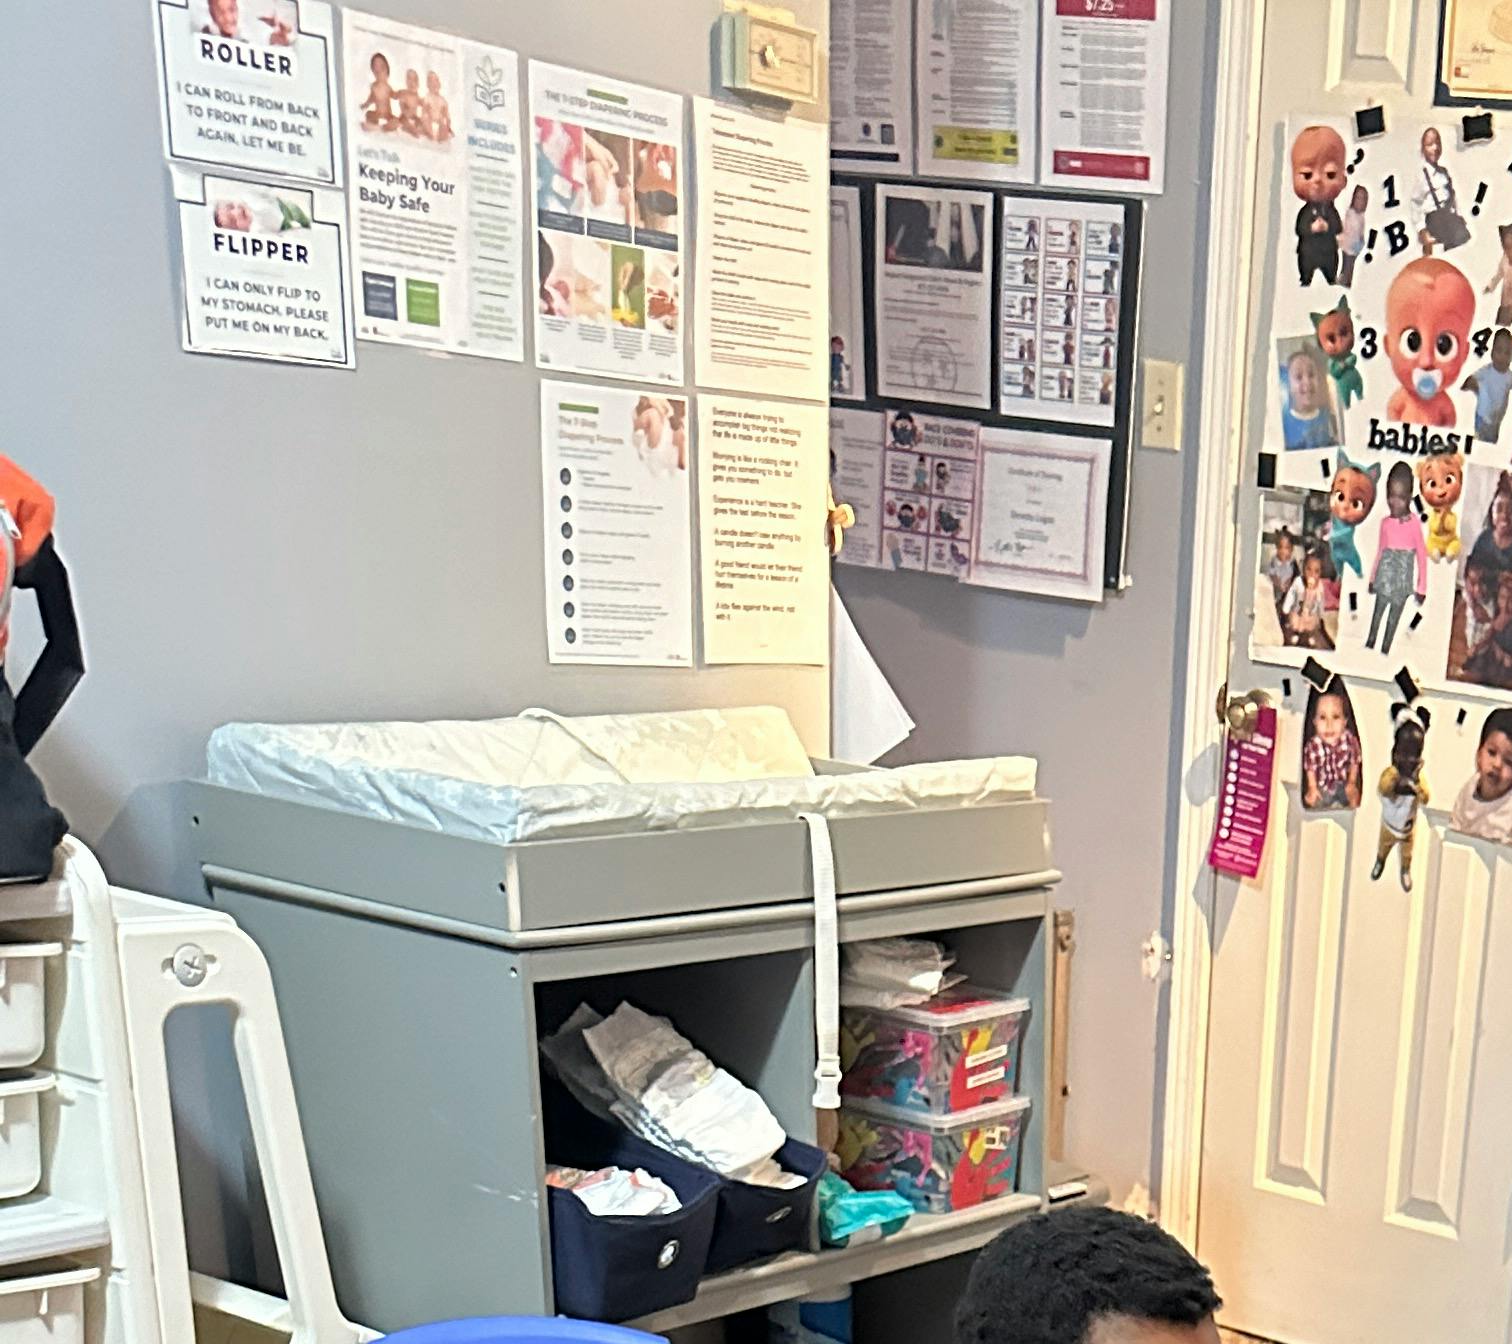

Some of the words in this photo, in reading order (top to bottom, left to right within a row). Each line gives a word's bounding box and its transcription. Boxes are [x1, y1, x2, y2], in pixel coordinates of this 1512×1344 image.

[200, 39, 292, 76] ROLLER
[176, 81, 181, 92] I
[185, 83, 210, 98] CAN
[215, 89, 245, 106] ROLL
[249, 96, 283, 114] FROM
[288, 103, 320, 120] BACK
[186, 104, 203, 117] TO
[207, 108, 248, 127] FRONT
[252, 117, 277, 131] AND
[281, 122, 313, 138] BACK
[242, 135, 263, 149] LET
[267, 139, 283, 153] ME
[359, 163, 417, 191] Keeping
[421, 176, 455, 195] Your
[1382, 175, 1400, 209] 1
[359, 187, 395, 209] Baby
[399, 194, 430, 213] Safe
[213, 233, 309, 264] FLIPPER
[1384, 220, 1409, 256] B
[206, 277, 211, 287] I
[214, 278, 239, 292] CAN
[243, 282, 274, 296] ONLY
[278, 286, 301, 300] FLIP
[305, 290, 321, 302] TO
[201, 296, 218, 308] MY
[286, 306, 329, 322] PLEASE
[206, 316, 227, 329] PUT
[232, 320, 249, 331] ME
[253, 321, 269, 333] ON
[274, 324, 290, 336] MY
[294, 326, 328, 341] BACK.
[1359, 327, 1378, 359] 3
